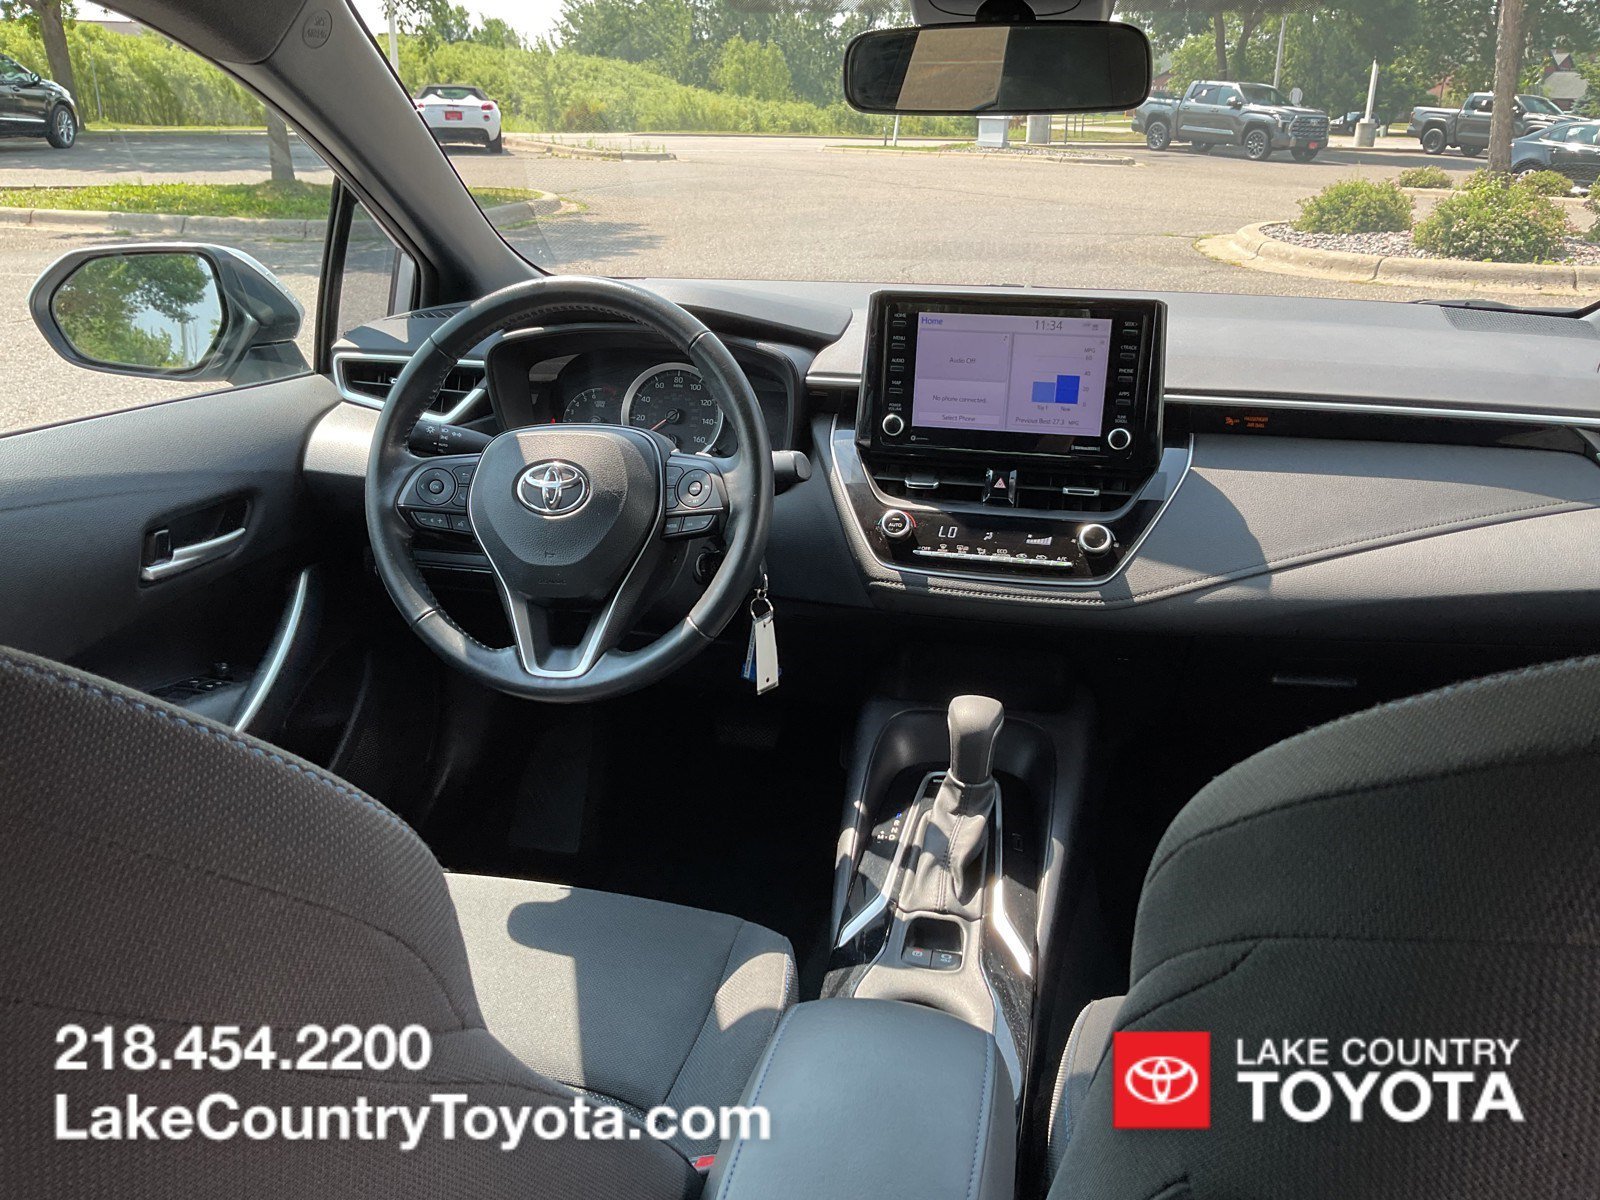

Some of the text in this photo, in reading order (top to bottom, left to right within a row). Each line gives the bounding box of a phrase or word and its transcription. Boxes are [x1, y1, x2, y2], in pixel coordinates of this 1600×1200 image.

[921, 317, 943, 325] Home
[1034, 320, 1063, 331] 11:34
[673, 376, 684, 384] 80
[1016, 416, 1038, 424] Previous
